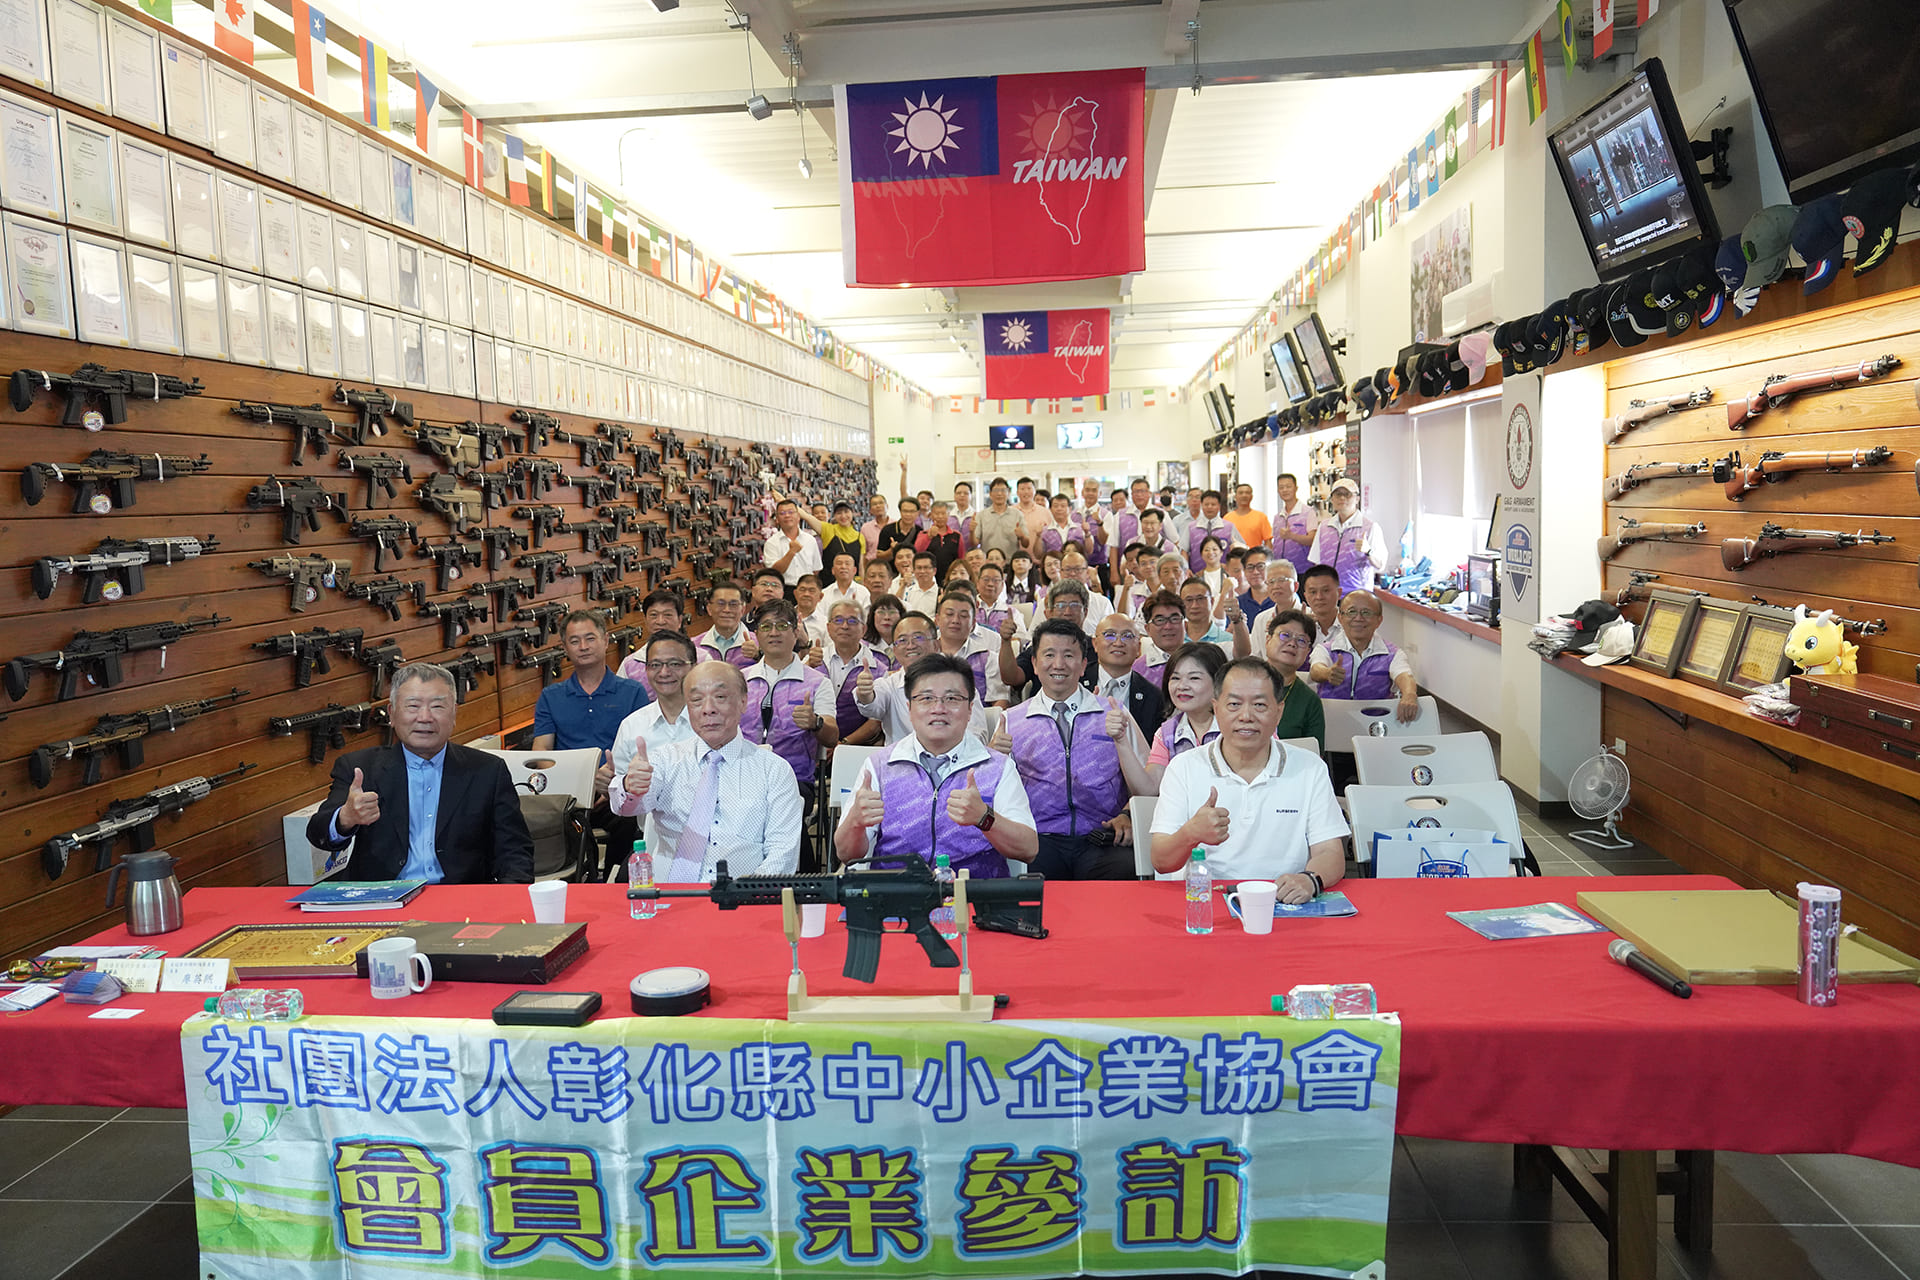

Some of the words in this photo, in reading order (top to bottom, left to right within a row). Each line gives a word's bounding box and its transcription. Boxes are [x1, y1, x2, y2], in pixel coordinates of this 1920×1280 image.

[1013, 156, 1127, 183] TAIWAN
[1054, 345, 1104, 357] TAIWAN
[202, 1025, 1382, 1123] 社團法人彰化縣中小企業協會
[331, 1132, 1251, 1264] 會員企業參訪
